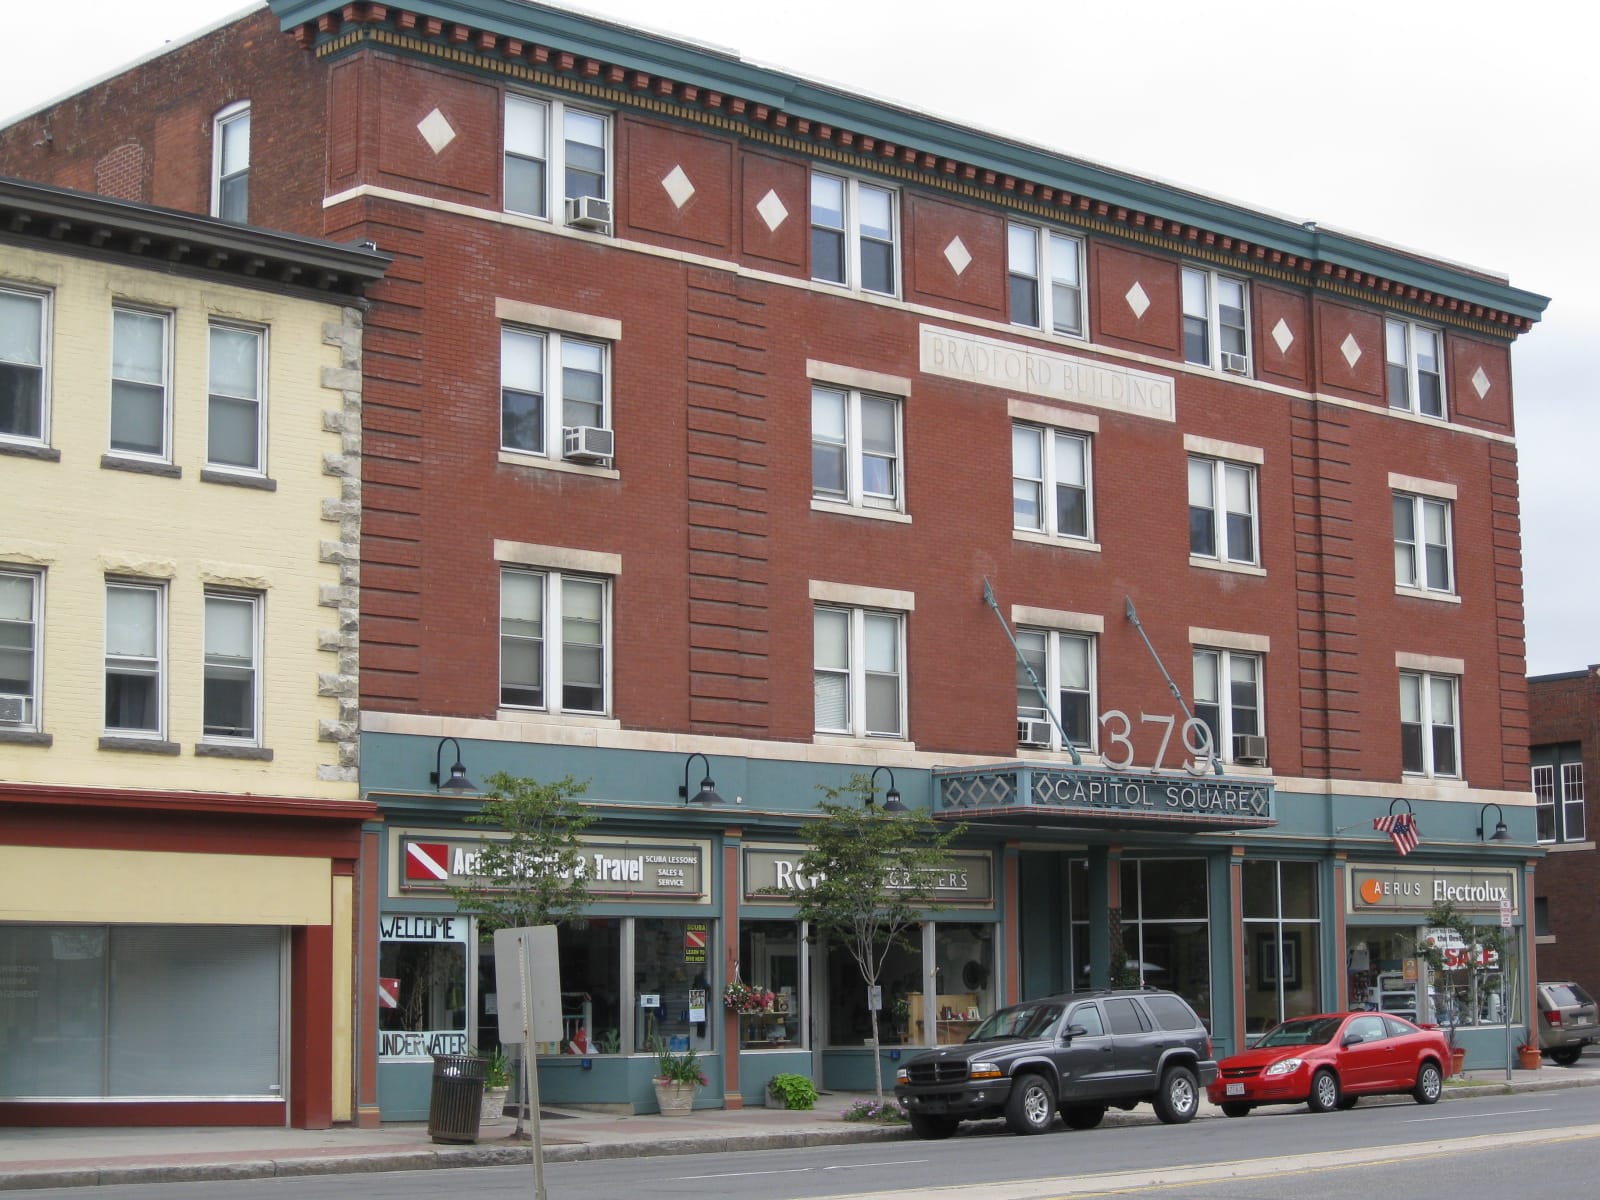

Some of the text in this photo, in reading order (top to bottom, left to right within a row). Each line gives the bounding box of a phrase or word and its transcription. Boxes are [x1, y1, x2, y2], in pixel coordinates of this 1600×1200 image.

[933, 337, 1163, 410] BRADFORD BUILDING
[1098, 709, 1215, 776] 379
[1055, 779, 1250, 811] CAPITOL SQUARE
[594, 853, 644, 881] Travel
[645, 855, 698, 864] SCUBA LESSONS
[657, 868, 677, 876] SALES
[657, 878, 684, 887] SERVICE
[1374, 880, 1508, 902] AERUS Electrolux
[380, 916, 456, 939] WELCOME
[1444, 947, 1497, 967] SALE
